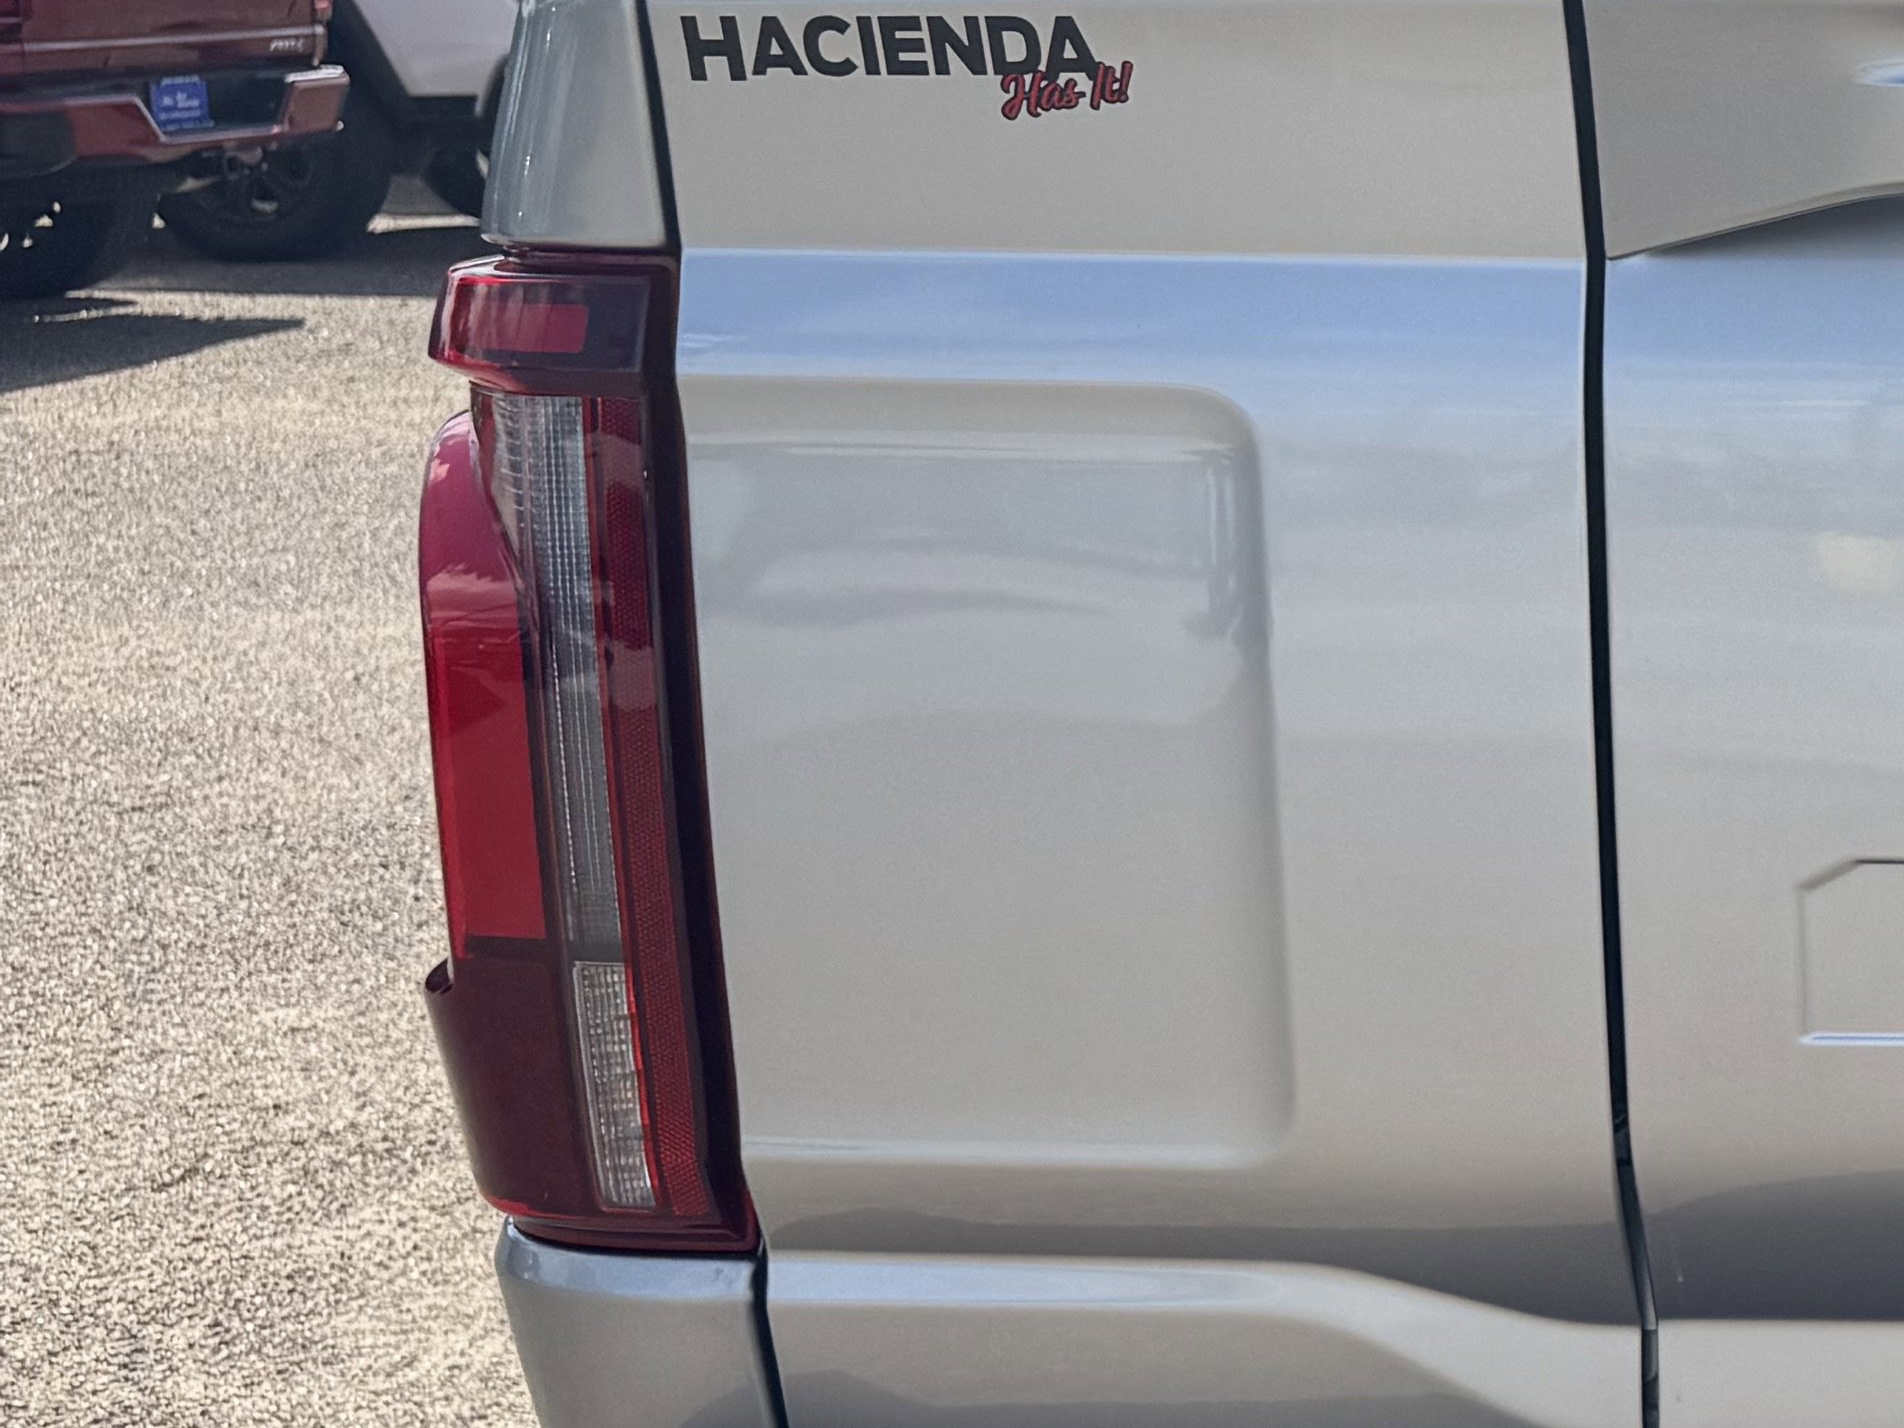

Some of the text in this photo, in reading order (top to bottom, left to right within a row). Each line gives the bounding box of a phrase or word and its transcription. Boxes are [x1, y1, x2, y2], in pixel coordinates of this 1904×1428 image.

[679, 14, 1101, 82] HACIENDA
[1001, 60, 1134, 121] Has It!
